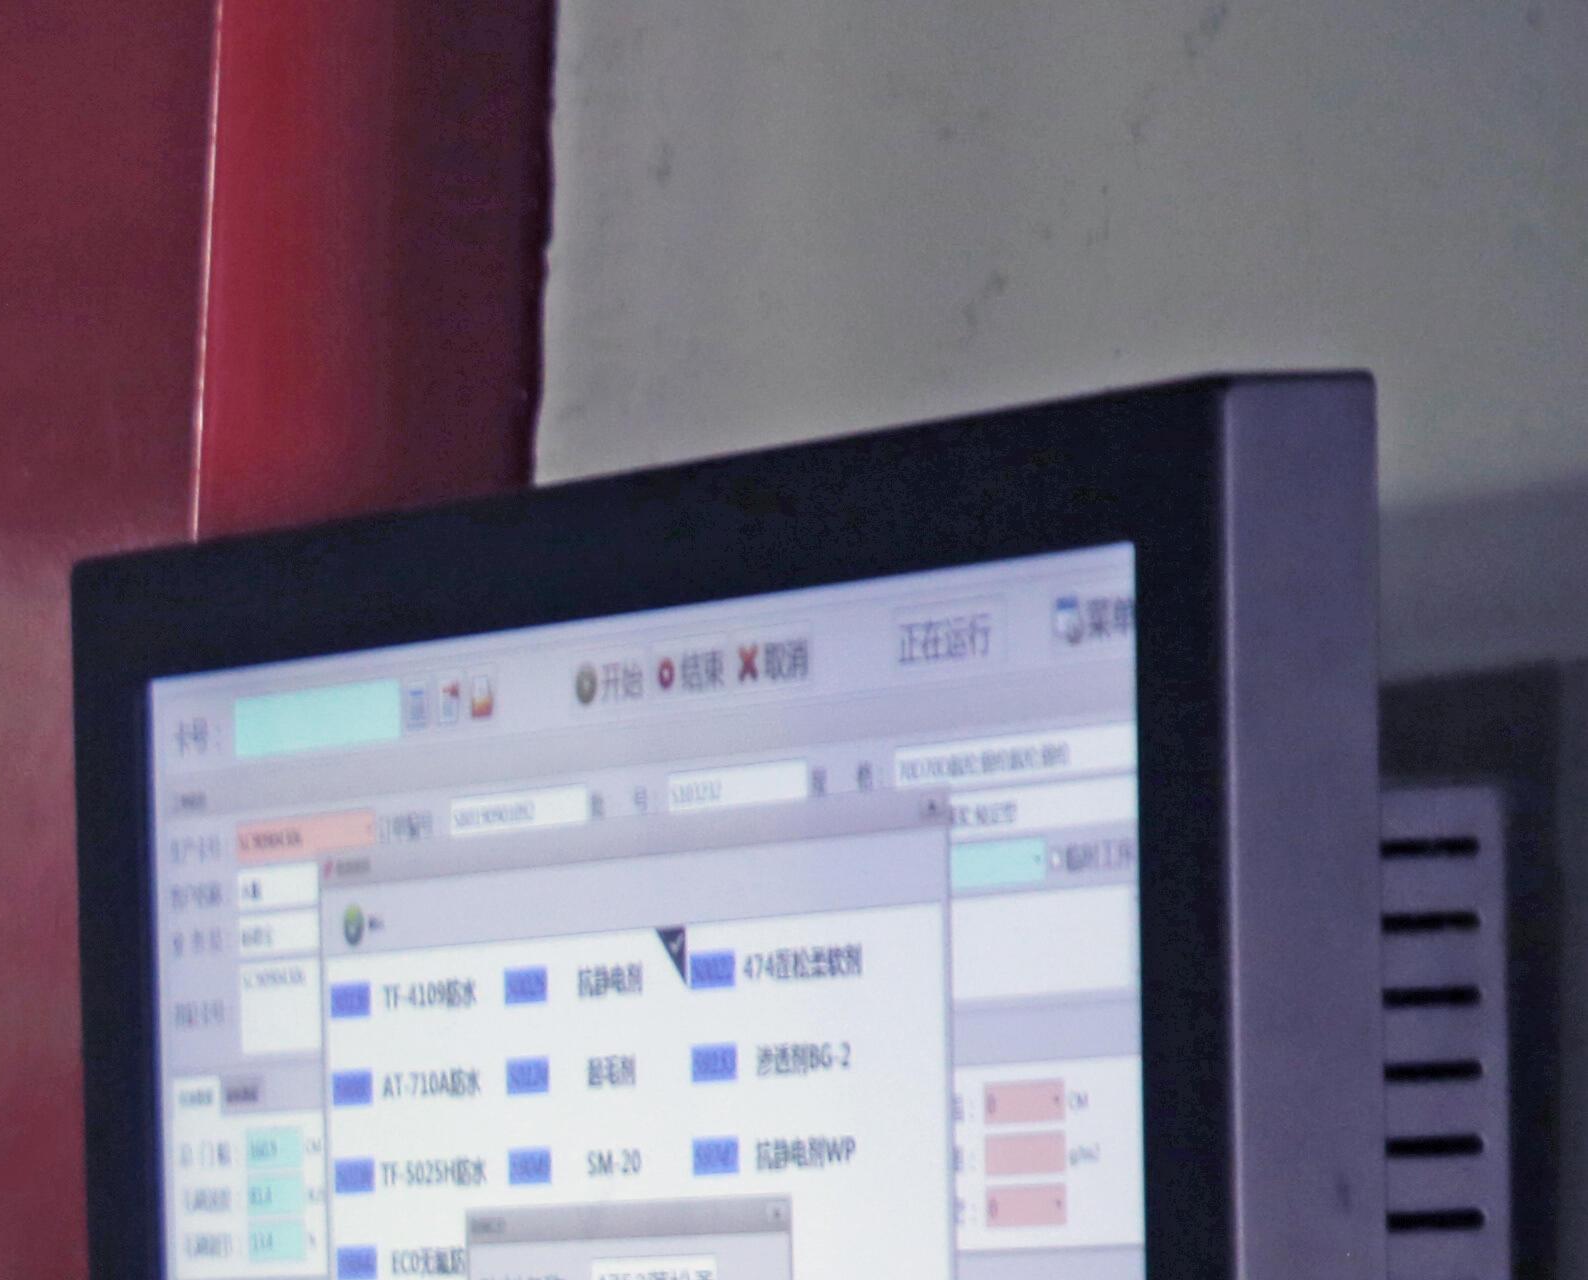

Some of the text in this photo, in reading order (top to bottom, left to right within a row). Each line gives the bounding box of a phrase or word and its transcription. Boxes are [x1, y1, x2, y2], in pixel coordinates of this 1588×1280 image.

[897, 613, 991, 666] 正在运行
[681, 649, 724, 692] 结束
[764, 639, 809, 682] 取消
[601, 662, 644, 699] 开始
[382, 978, 477, 1010] TF-4109防水
[382, 1068, 481, 1098] AT-710A防水
[586, 1147, 641, 1177] SM-20
[755, 1134, 856, 1173] 抗静电剂WP
